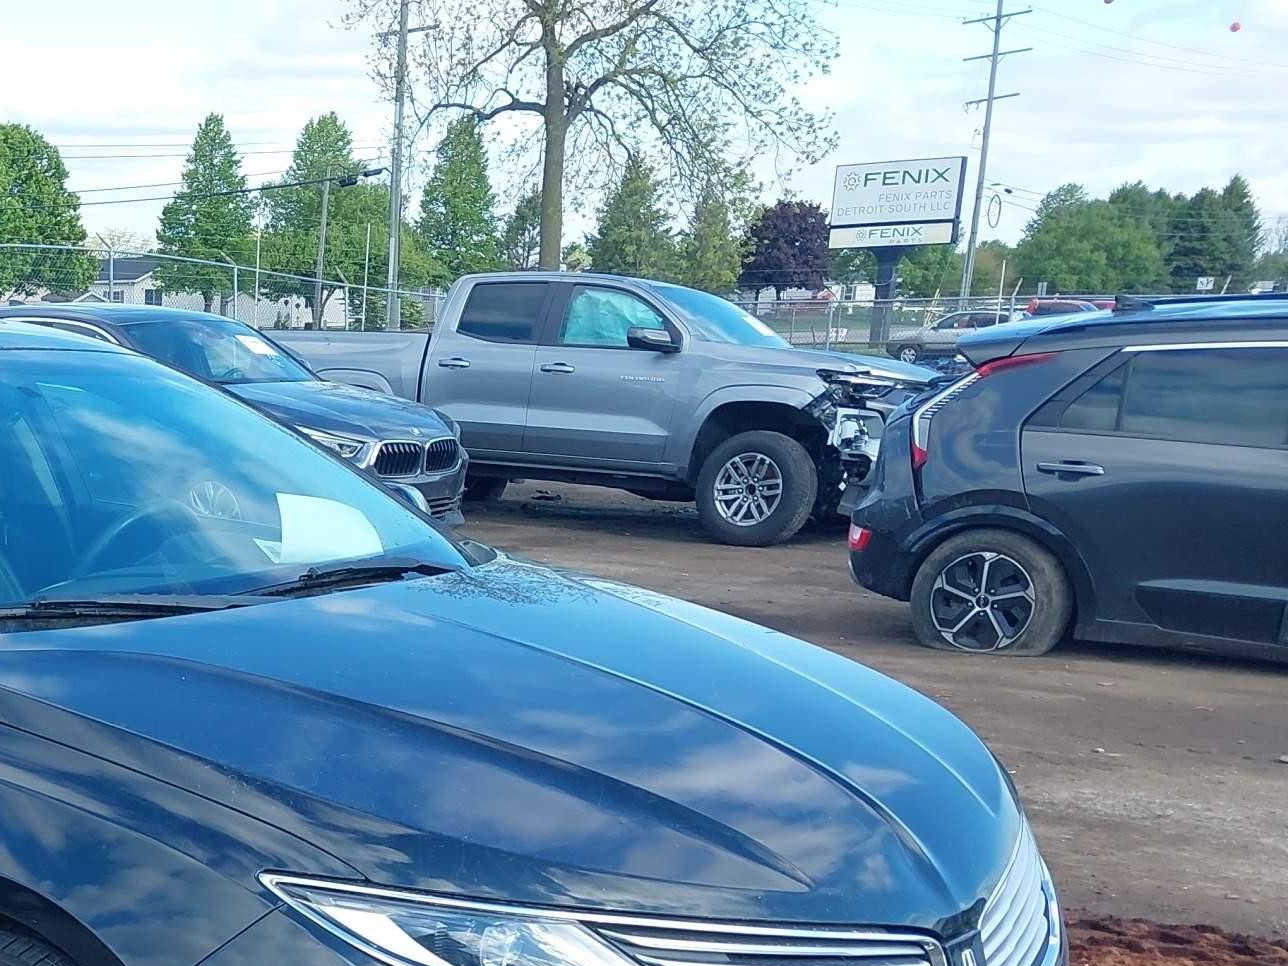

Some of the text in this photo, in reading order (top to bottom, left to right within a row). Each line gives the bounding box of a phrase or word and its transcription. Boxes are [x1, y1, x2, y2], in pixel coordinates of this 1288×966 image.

[863, 167, 951, 188] FENIX
[878, 190, 952, 203] FENIX PARTS
[837, 201, 951, 217] DETROIT SOUTH LLC
[868, 226, 923, 239] FENIX
